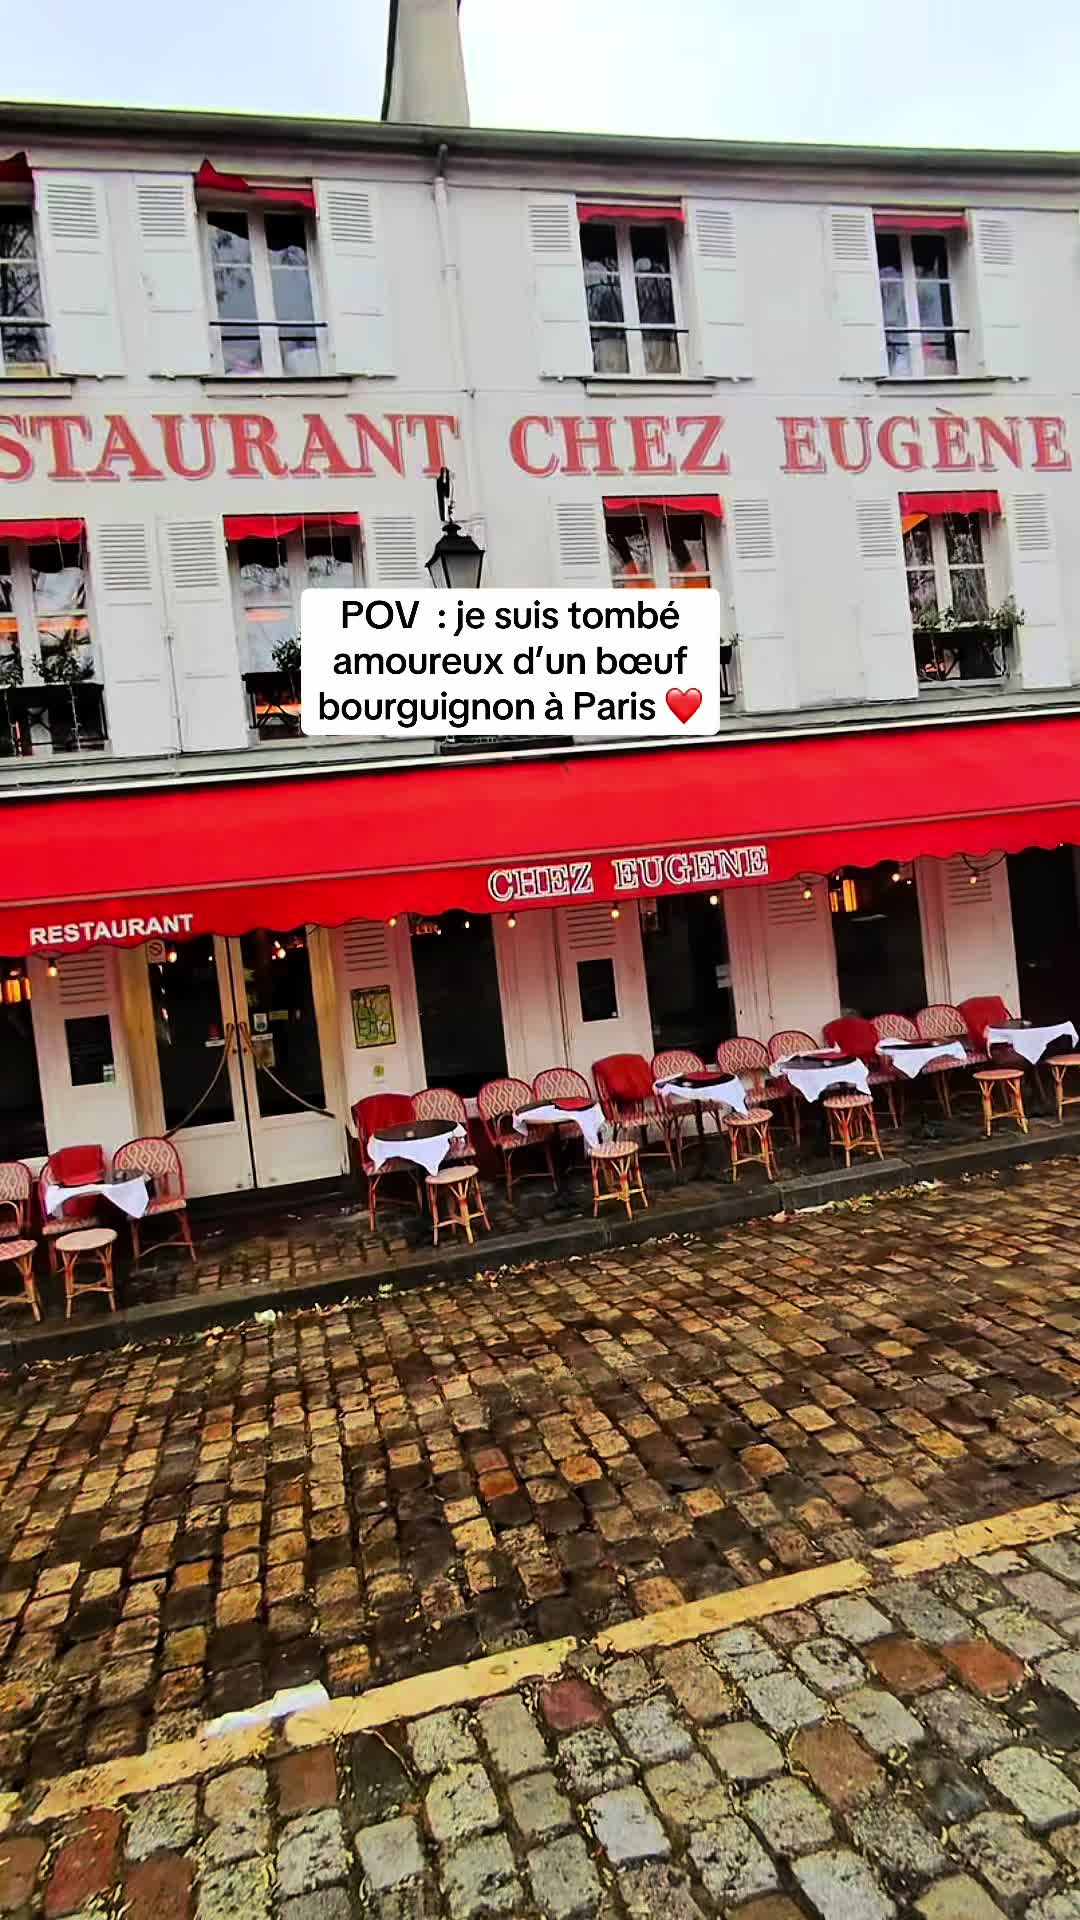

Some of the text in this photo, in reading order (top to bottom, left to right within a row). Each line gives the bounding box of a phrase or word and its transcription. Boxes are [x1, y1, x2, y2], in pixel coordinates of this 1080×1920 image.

[509, 415, 731, 477] CHEZ
[776, 407, 1074, 474] EUGÈNE
[487, 845, 769, 902] CHEZ EUGENE
[29, 913, 194, 946] RESTAURANT
